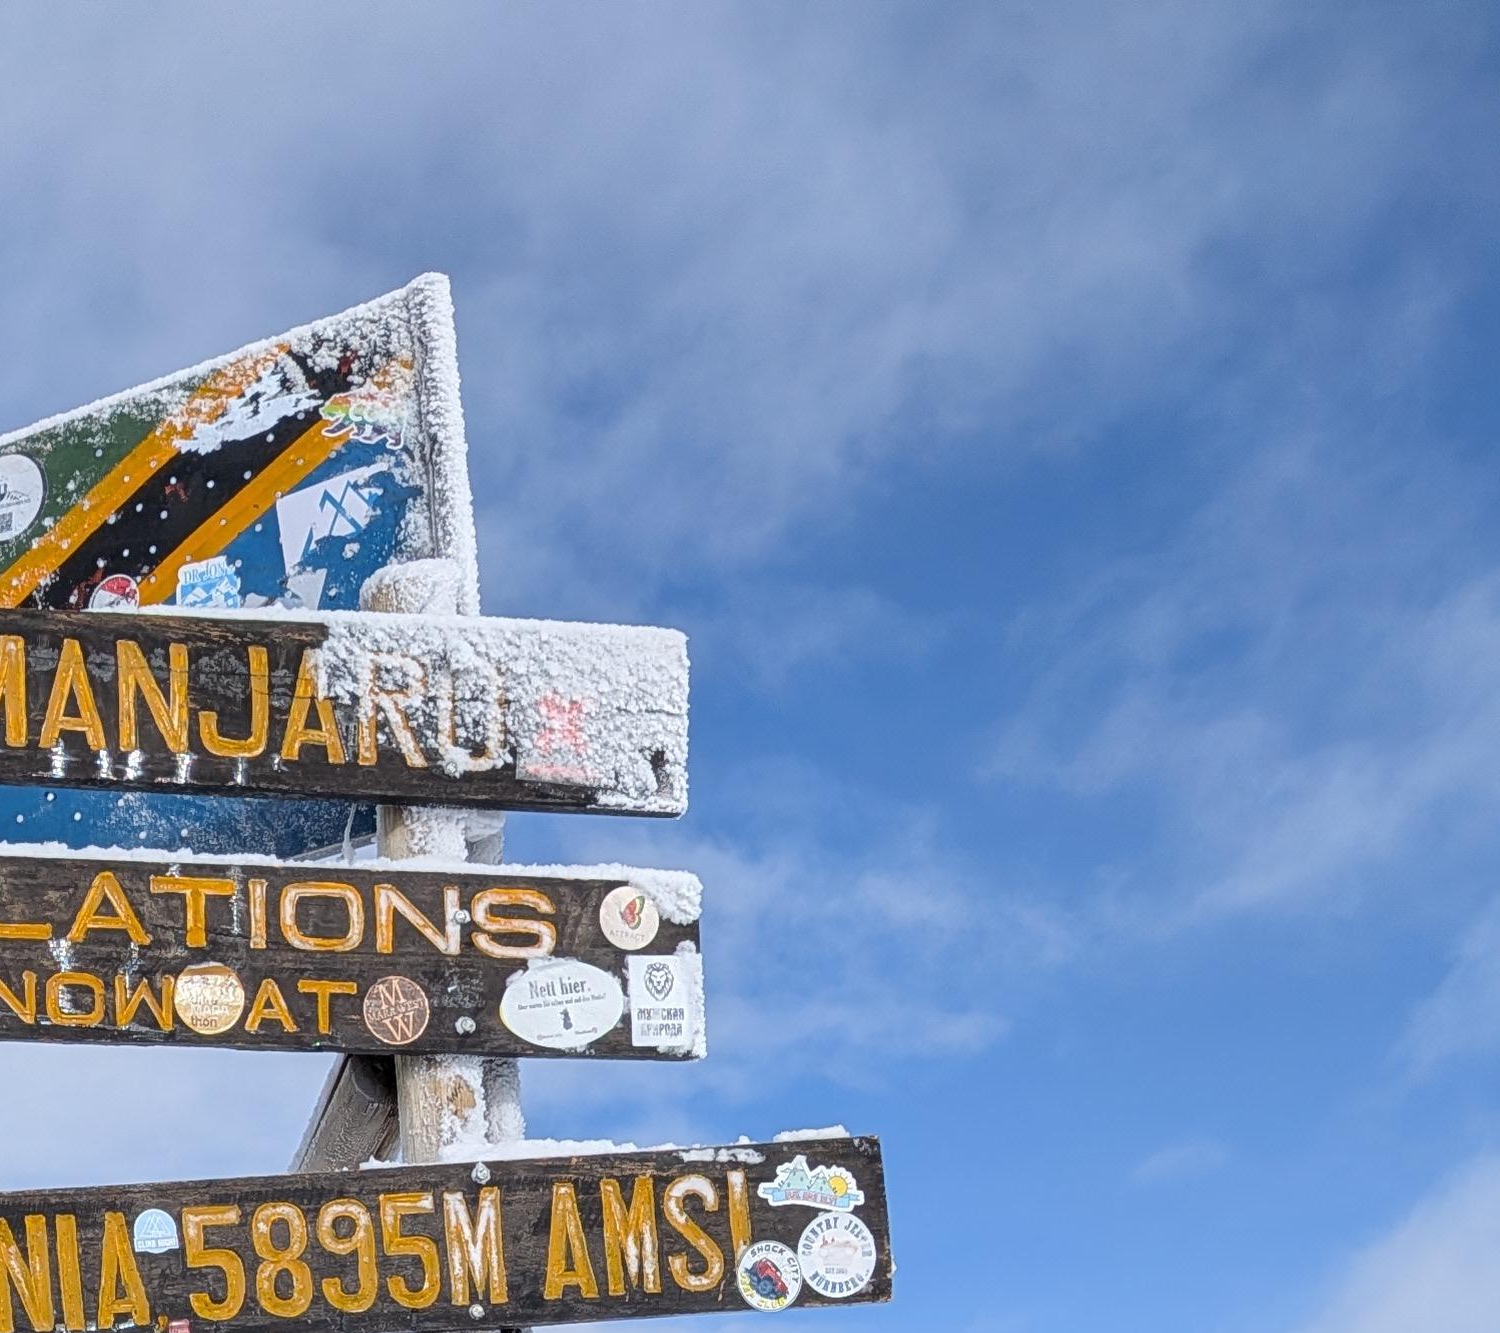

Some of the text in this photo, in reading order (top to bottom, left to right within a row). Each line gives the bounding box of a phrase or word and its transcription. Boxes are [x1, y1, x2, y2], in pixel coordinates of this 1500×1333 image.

[244, 977, 358, 1035] AT
[528, 976, 591, 1000] Nett hier.
[180, 1185, 508, 1323] 5895M
[750, 1243, 785, 1258] SHOCK
